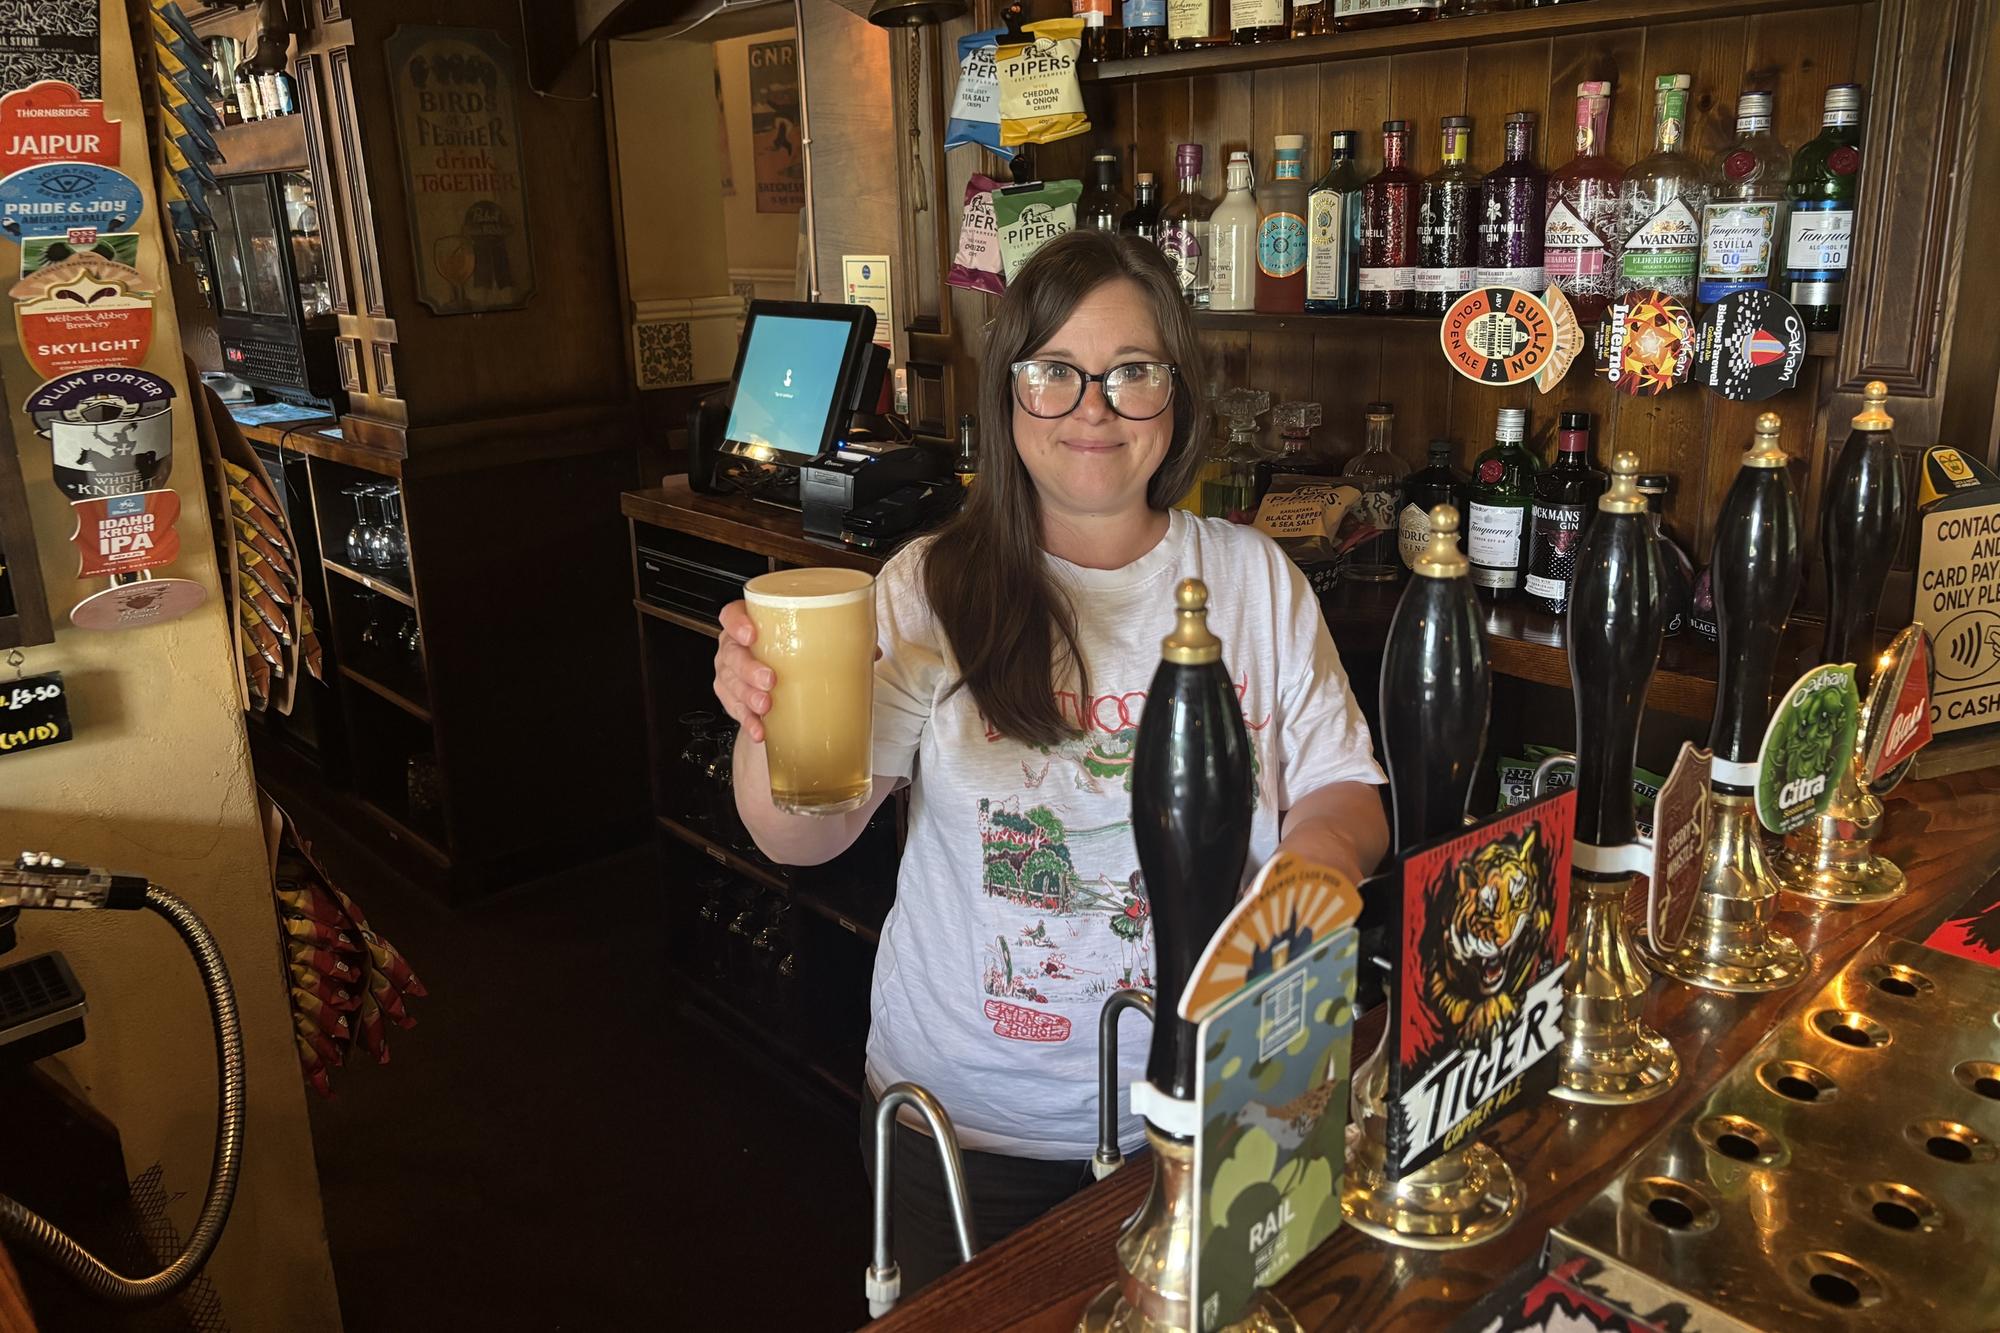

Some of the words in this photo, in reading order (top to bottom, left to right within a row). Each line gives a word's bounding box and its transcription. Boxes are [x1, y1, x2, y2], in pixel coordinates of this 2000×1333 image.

[10, 37, 40, 46] STOUT
[751, 46, 794, 68] GNR
[1009, 55, 1071, 78] PIPERS
[419, 91, 498, 113] BIRDS
[973, 94, 991, 102] SALT
[1022, 88, 1060, 99] CHEDDAR
[1033, 96, 1059, 105] ONION
[16, 109, 91, 117] THORNBRIDGE
[6, 134, 100, 155] JAIPUR
[436, 149, 497, 171] drink
[5, 202, 66, 215] PRIDE
[68, 201, 84, 213] &
[87, 199, 127, 212] JOY
[21, 213, 79, 224] AMERICAN
[82, 212, 107, 222] PALE
[1008, 221, 1067, 244] PIPERS
[1365, 229, 1385, 238] NEILL
[1434, 226, 1458, 235] NEILL
[1500, 223, 1526, 233] NEILL
[1709, 225, 1762, 238] Tanqueray
[1797, 228, 1851, 245] Tanquer
[1159, 229, 1174, 241] LUM
[1176, 231, 1193, 246] GIN
[1421, 235, 1433, 244] GIN
[1487, 234, 1499, 243] GIN
[1712, 240, 1753, 250] SEVILLA
[1721, 253, 1740, 265] 0.0
[45, 314, 97, 323] Welbeck
[97, 312, 130, 321] Abbey
[66, 321, 111, 330] Brewery
[1450, 300, 1482, 350] GOLDEN
[1714, 304, 1727, 343] Bishops
[1478, 320, 1488, 350] BREWERY
[1486, 314, 1497, 357] NOTTINGHAM
[1511, 299, 1547, 374] BULLION
[1604, 324, 1612, 346] Blonde
[1608, 304, 1629, 382] Inferno
[1706, 326, 1714, 350] Golden
[38, 339, 141, 356] SKYLIGHT
[1673, 315, 1692, 377] Oakham
[1778, 316, 1802, 381] Oakham
[1458, 351, 1479, 370] ALE
[1704, 350, 1712, 361] Ale
[1709, 344, 1723, 386] Farewell
[38, 377, 87, 407] PLUM
[92, 373, 163, 397] PORTER
[78, 478, 154, 496] KNIGHT
[95, 473, 142, 486] WHITE
[99, 513, 155, 530] IDAHO
[1531, 504, 1579, 522] OCKMANS
[99, 523, 155, 539] KRUSH
[1278, 520, 1294, 528] SEA
[1296, 518, 1316, 526] SALT
[1470, 521, 1513, 538] Tanqueray
[1559, 522, 1579, 531] GIN
[99, 533, 155, 556] IPA
[1400, 529, 1430, 543] NDRIC
[1922, 565, 1968, 592] CARD
[1971, 560, 2000, 584] PAY
[1933, 587, 1975, 613] ONLY
[1792, 670, 1849, 708] Oakham
[1948, 694, 2000, 720] CASH
[1778, 774, 1826, 810] Citra
[1423, 1000, 1549, 1144] TIGER
[1443, 1097, 1494, 1151] COPPER
[1496, 1072, 1526, 1110] ALE
[1249, 1198, 1296, 1253] RAIL
